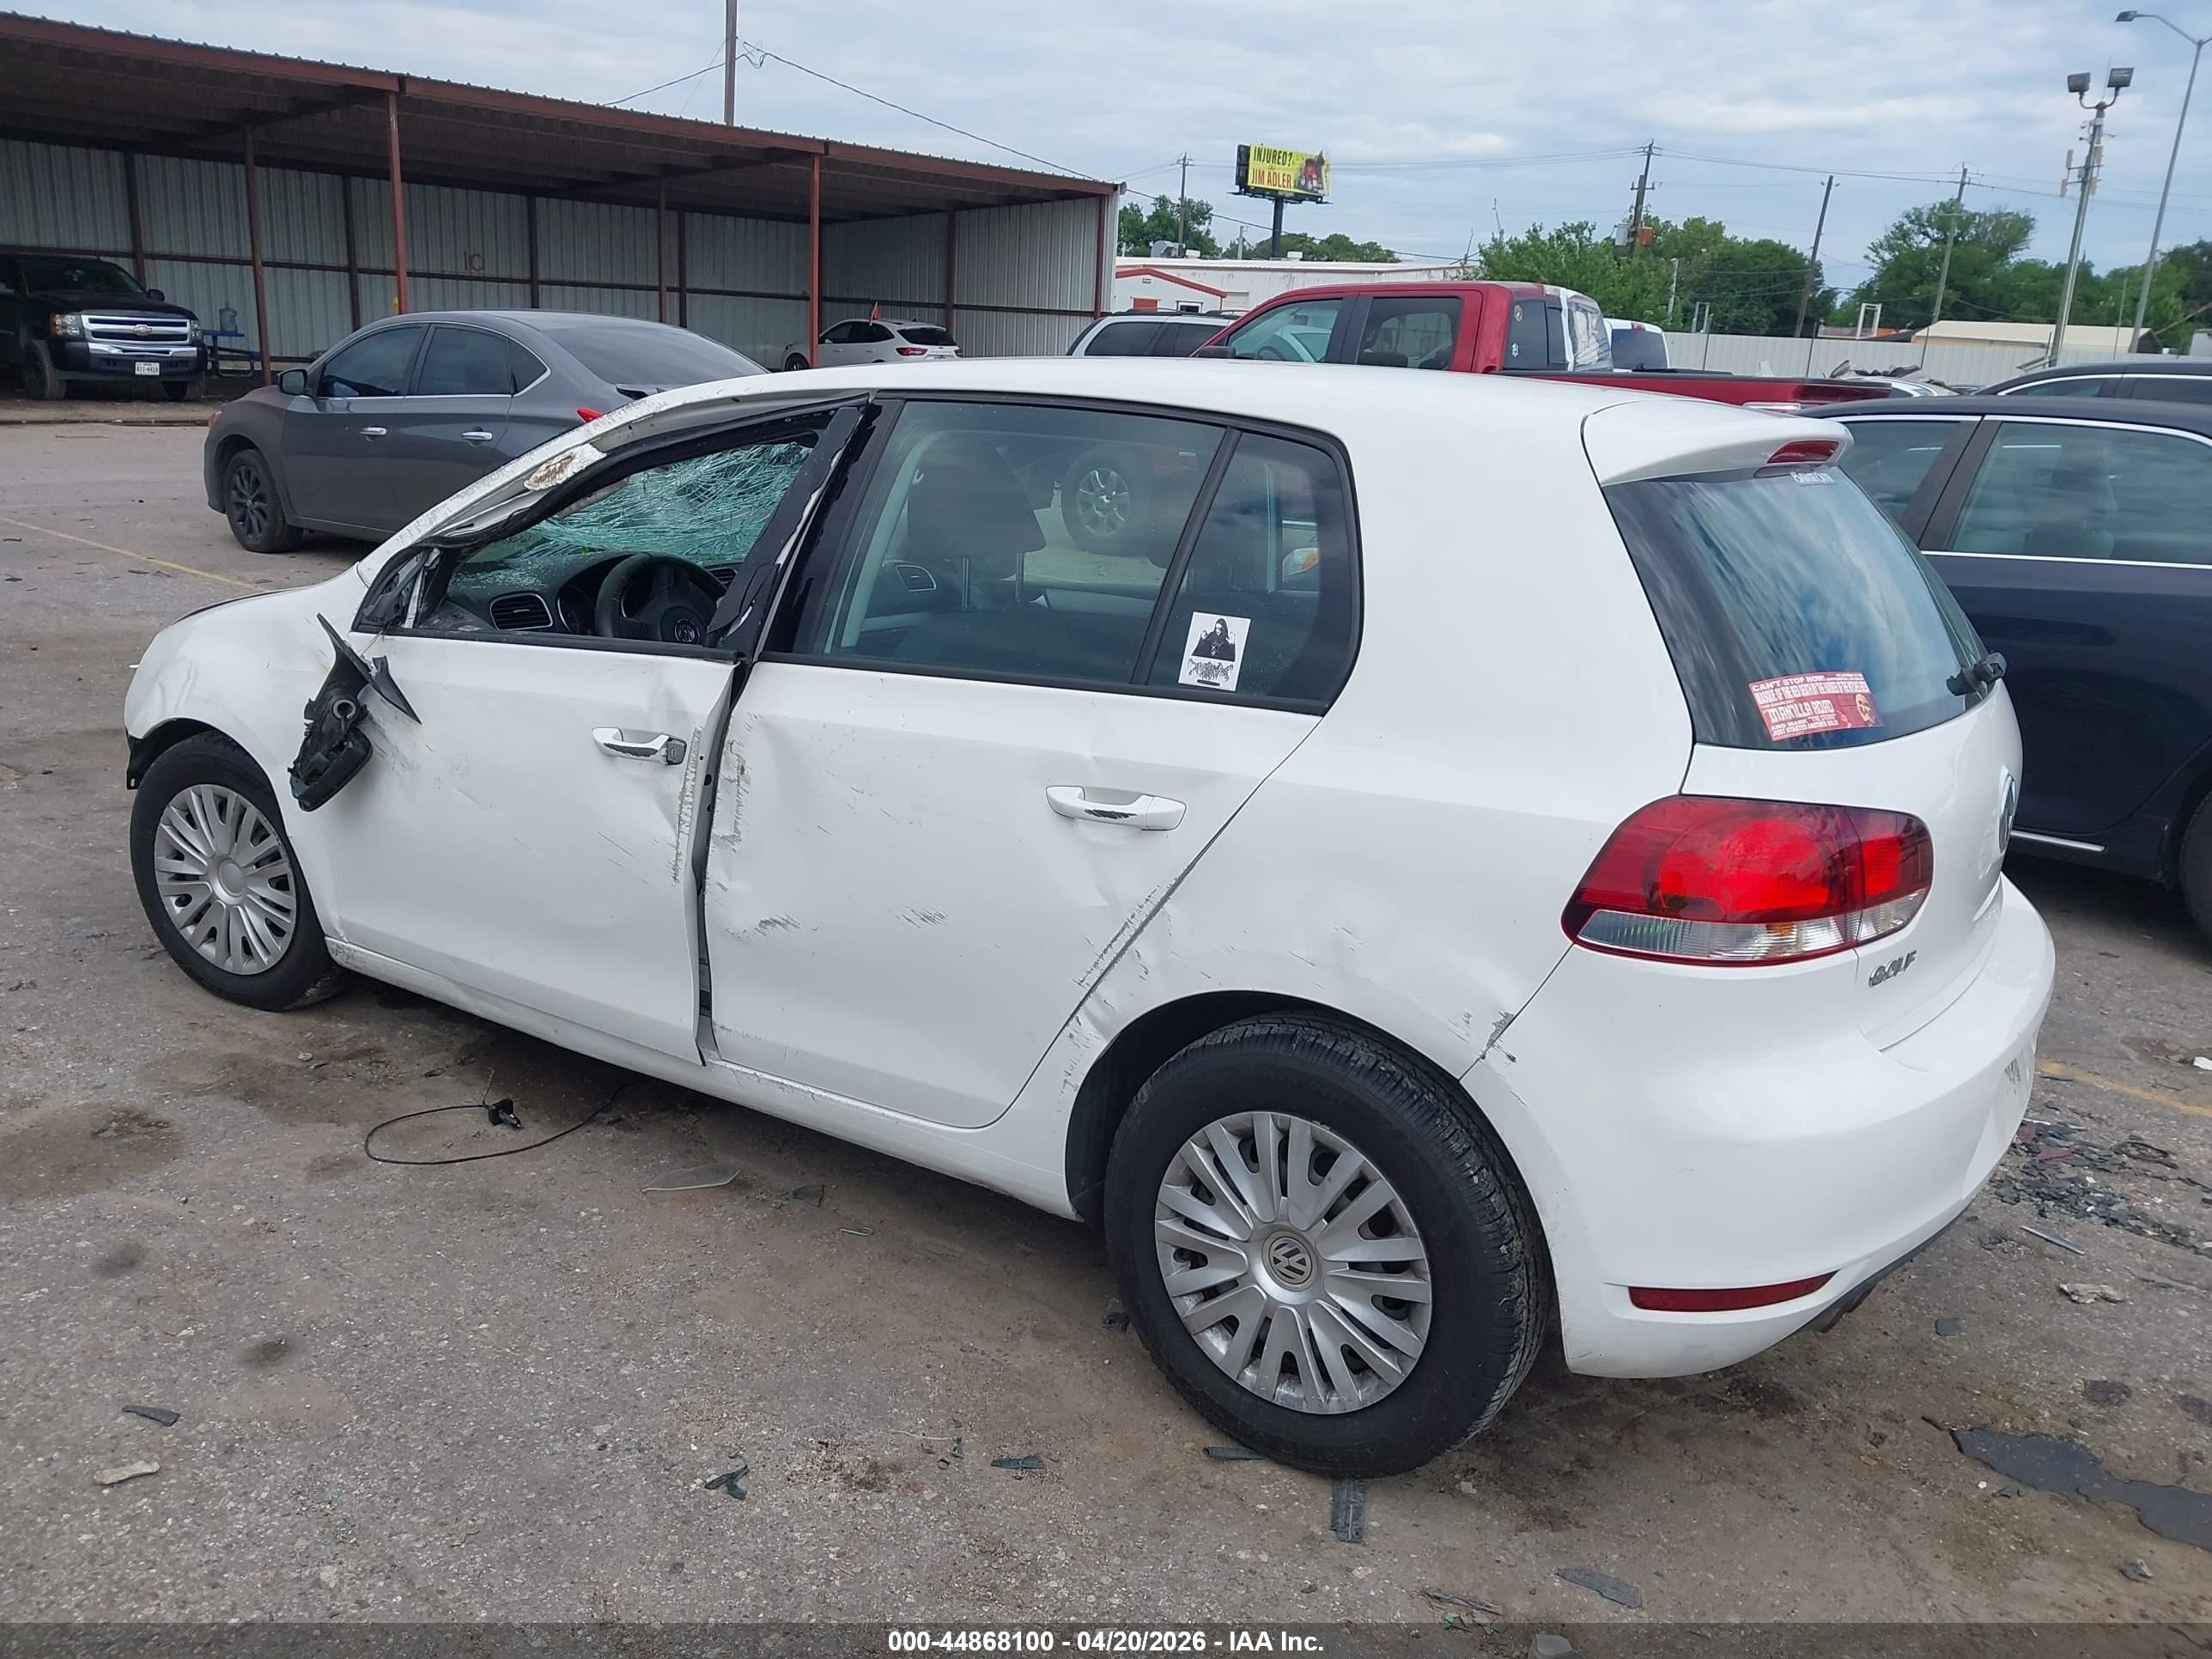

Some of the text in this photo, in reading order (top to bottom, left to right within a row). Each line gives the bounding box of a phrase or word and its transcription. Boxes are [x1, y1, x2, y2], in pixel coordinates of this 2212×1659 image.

[1254, 147, 1293, 167] INJURED?
[1251, 168, 1292, 190] JIM ADLER
[1753, 679, 1781, 691] CAN'T
[1784, 677, 1804, 686] STOP
[1766, 702, 1811, 723] MANILLA
[1811, 699, 1835, 714] ROAD
[1869, 948, 1917, 988] GOLF
